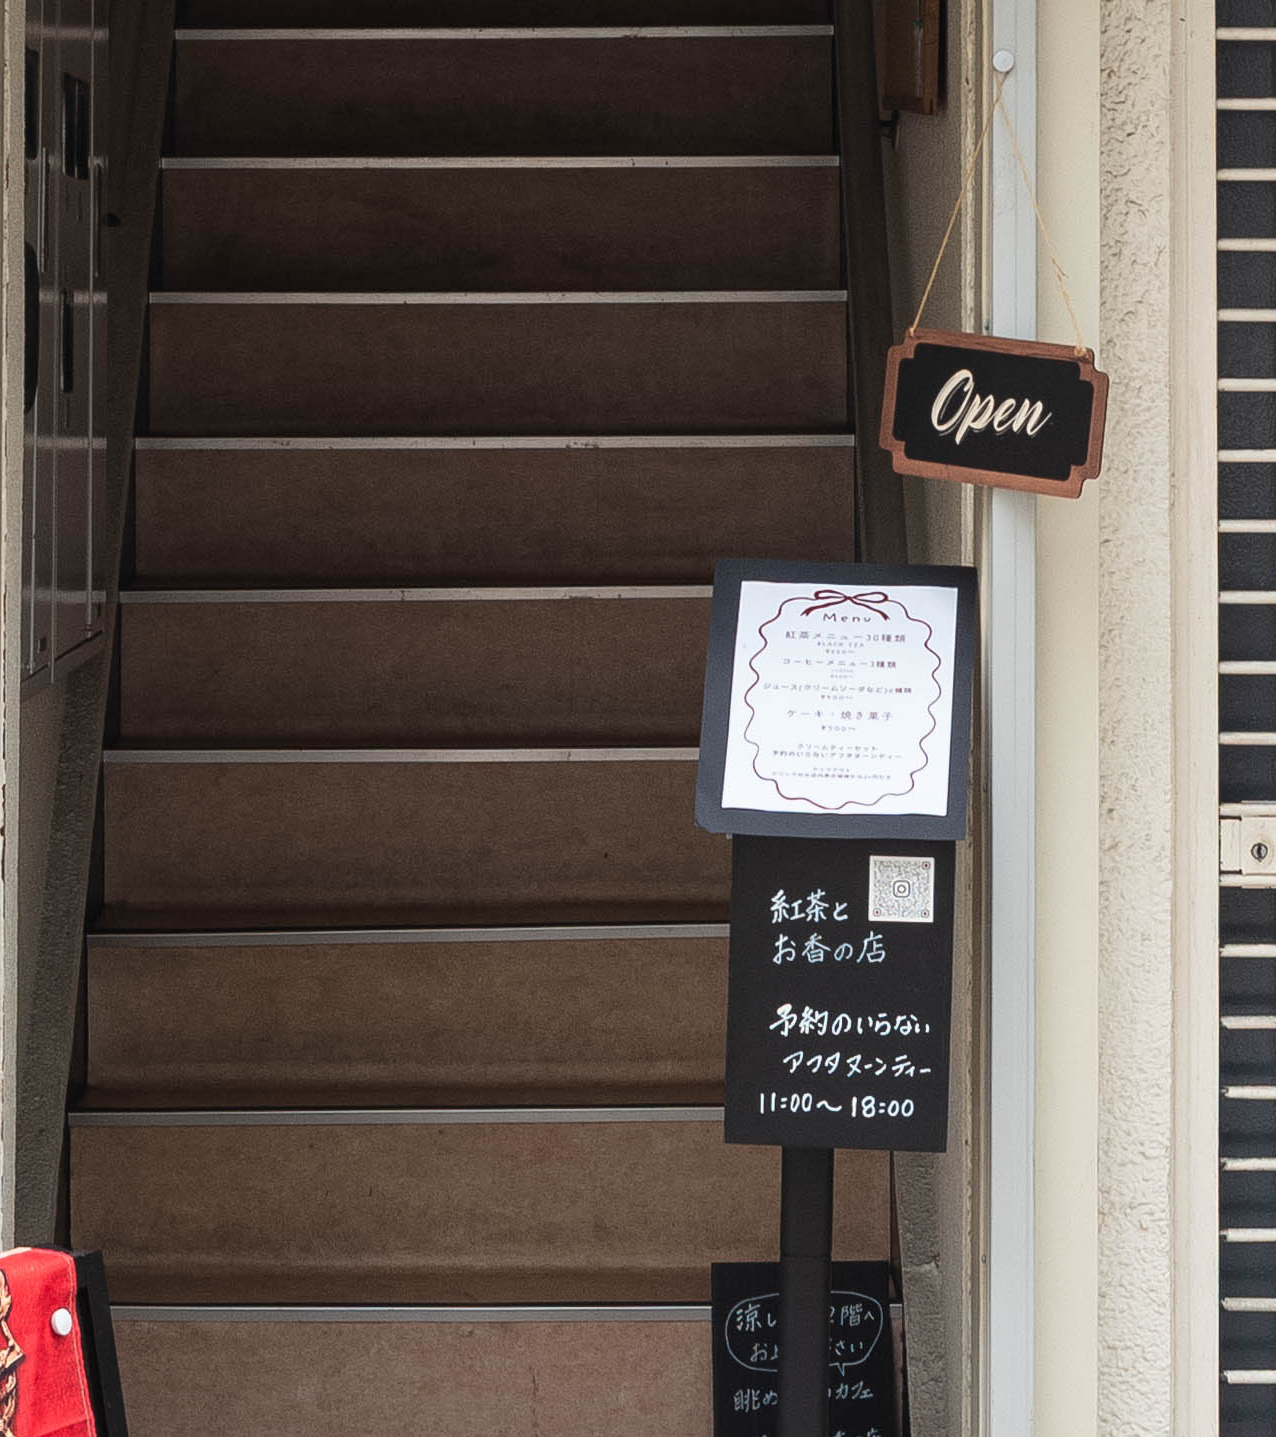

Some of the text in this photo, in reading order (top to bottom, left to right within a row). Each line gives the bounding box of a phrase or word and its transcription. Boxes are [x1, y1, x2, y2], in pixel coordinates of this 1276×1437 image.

[931, 368, 1053, 446] Open
[822, 612, 872, 623] Menu
[770, 888, 849, 924] 紅茶と
[773, 930, 886, 965] お香の店
[769, 1003, 930, 1037] 予約のいらない
[783, 1050, 931, 1078] アフタヌーンティー
